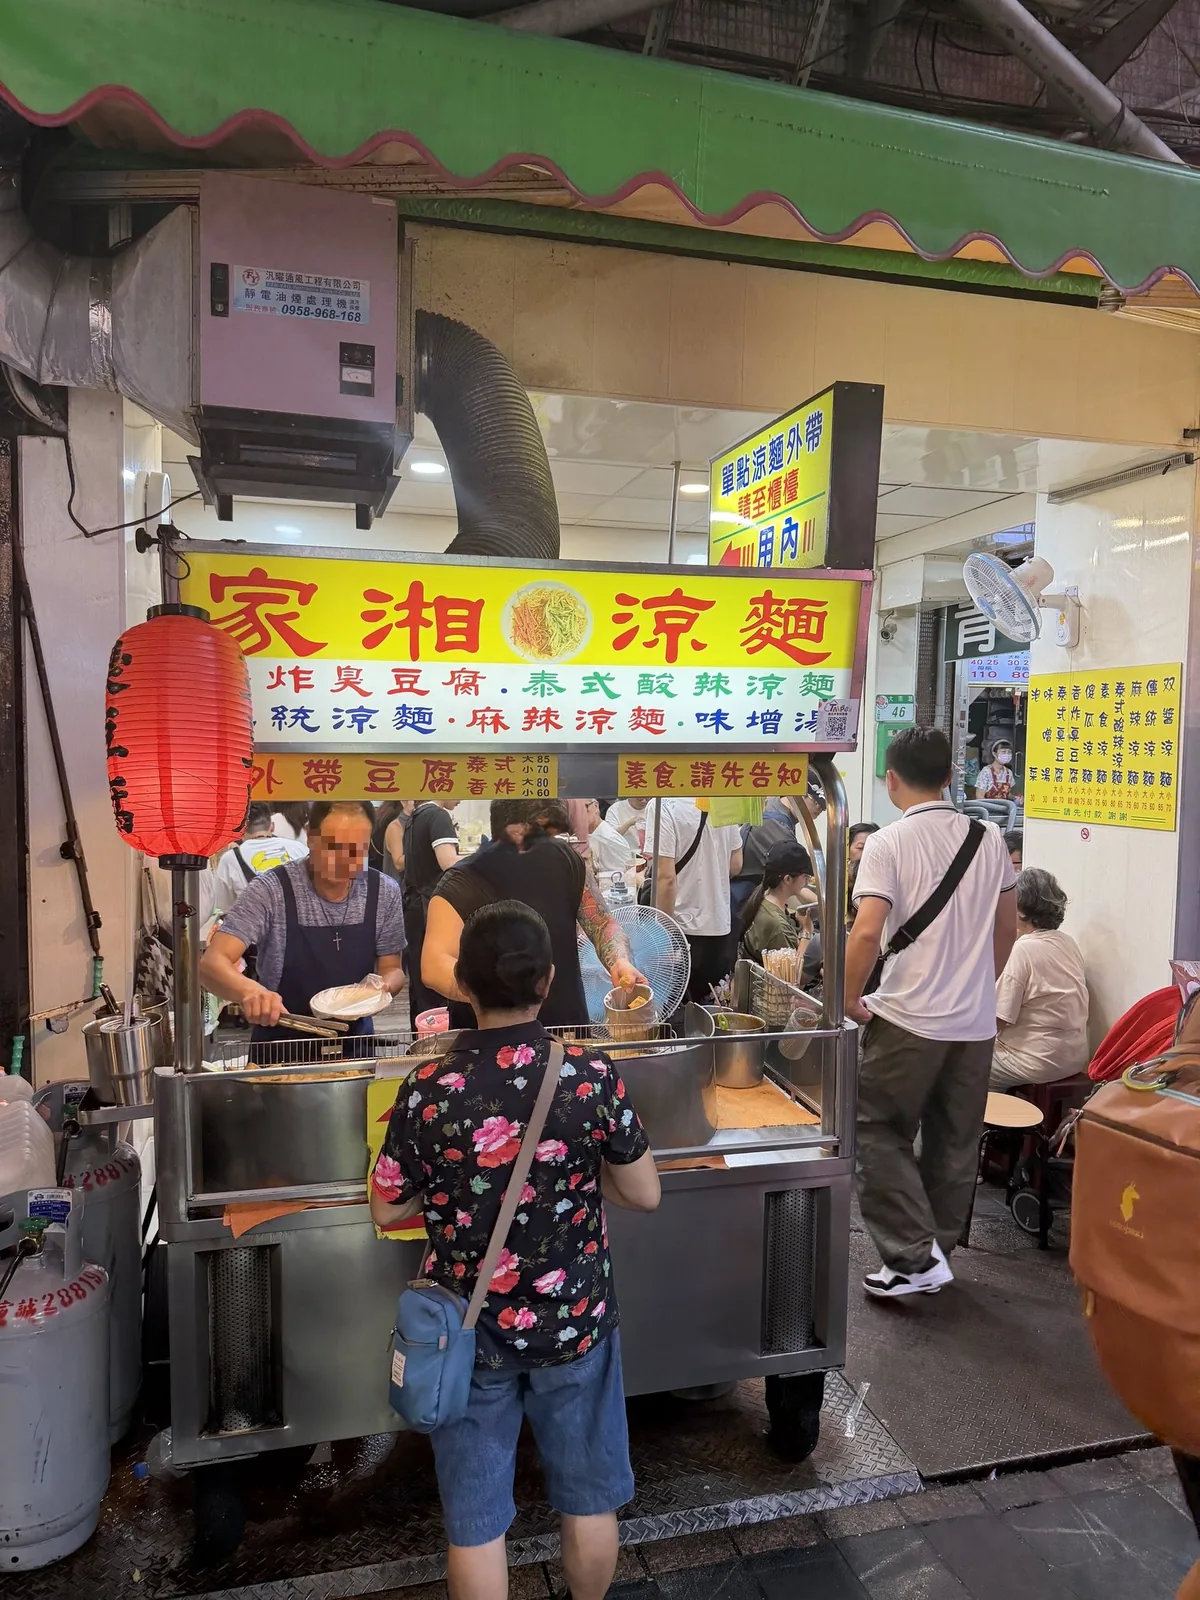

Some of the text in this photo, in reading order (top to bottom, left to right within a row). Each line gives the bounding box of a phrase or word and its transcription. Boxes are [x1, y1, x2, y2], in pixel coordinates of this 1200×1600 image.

[281, 304, 362, 323] 0958-968-168
[721, 410, 824, 497] 單點涼麵外帶
[209, 567, 832, 666] 家湘 涼麵
[972, 670, 998, 679] 110
[892, 706, 907, 718] 46
[1096, 682, 1110, 785] 素食涼麵
[1127, 680, 1142, 786] 麻辣涼麵
[1142, 679, 1158, 787] 傳統涼麵
[466, 755, 550, 773] 泰式 大 85
[522, 766, 549, 774] 小 70
[250, 758, 458, 794] 外帶豆腐
[466, 778, 549, 795] 香炸 大 80
[522, 789, 550, 797] 小 60
[1063, 808, 1128, 821] 請先付款 謝謝
